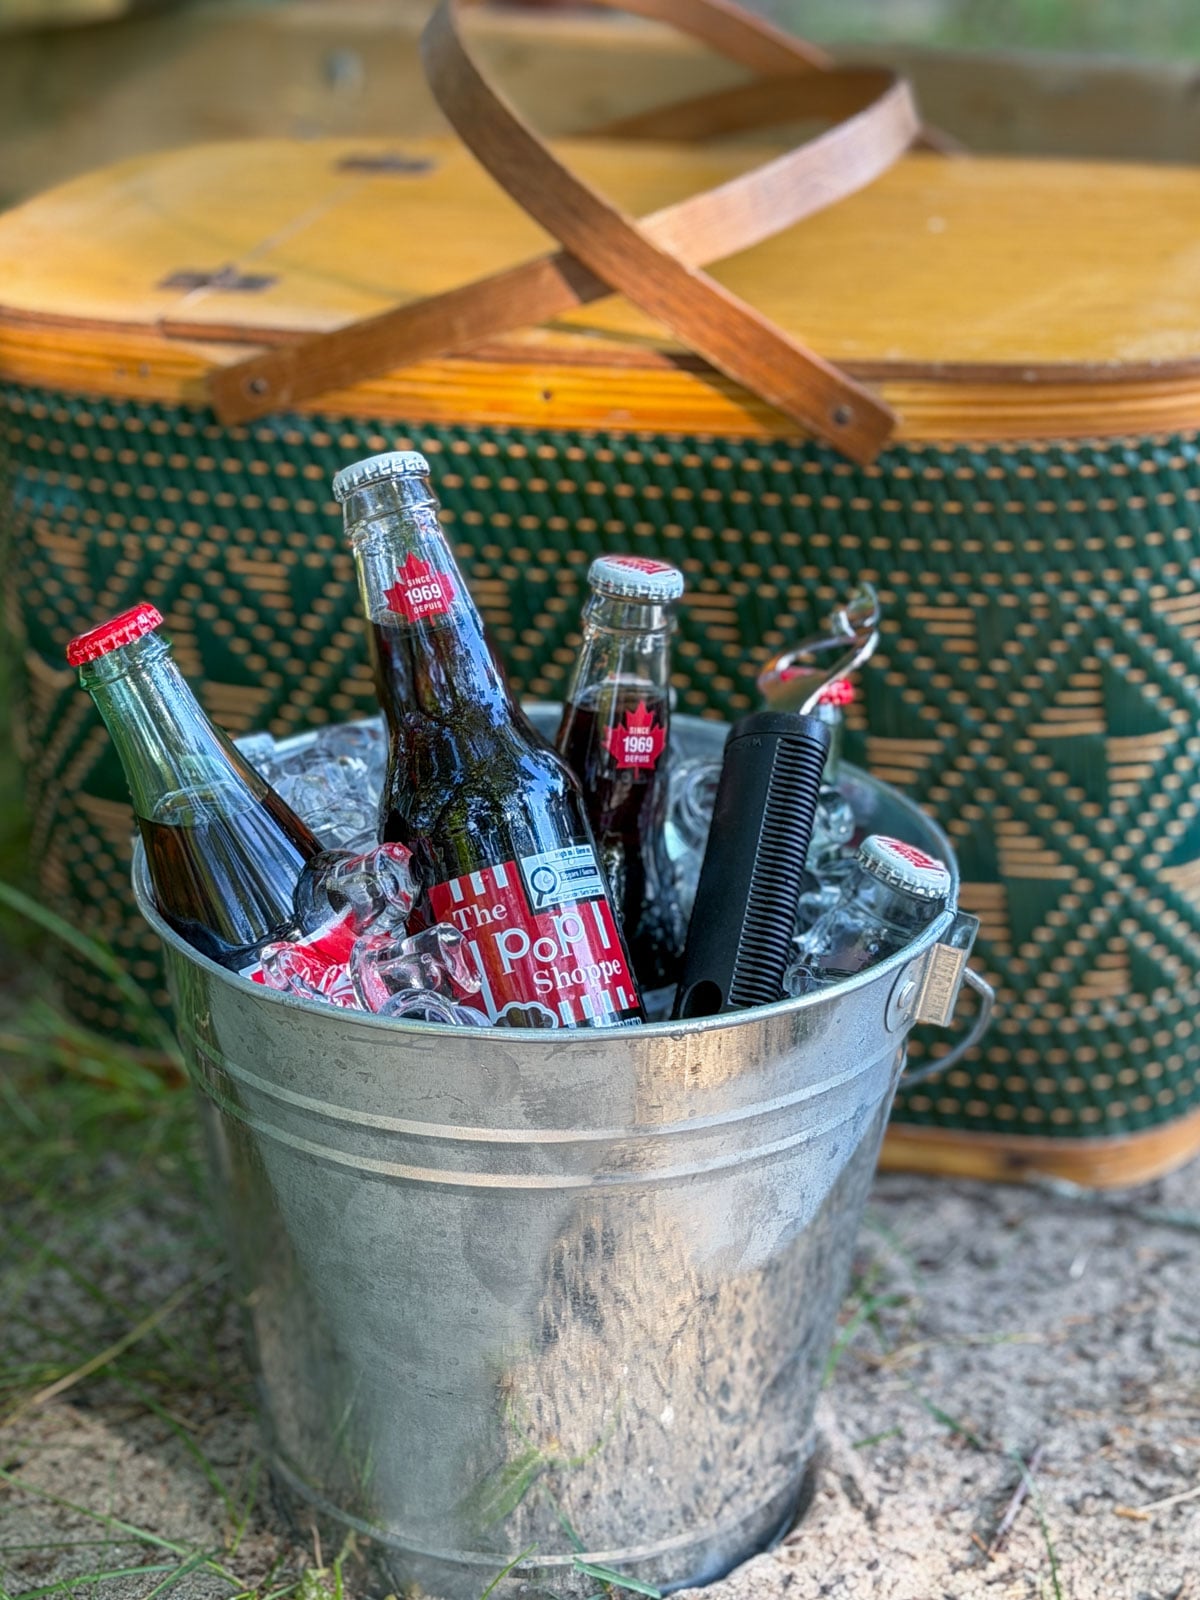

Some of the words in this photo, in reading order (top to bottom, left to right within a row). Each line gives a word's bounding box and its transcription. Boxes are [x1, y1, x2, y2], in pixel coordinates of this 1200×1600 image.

[407, 575, 432, 587] SINCE
[405, 583, 442, 605] 1969
[413, 601, 442, 614] DEPUIS
[629, 726, 651, 735] SINCE
[622, 736, 654, 753] 1969
[624, 754, 650, 763] DEPUIS
[452, 903, 508, 932] The
[532, 958, 623, 994] Shoppe
